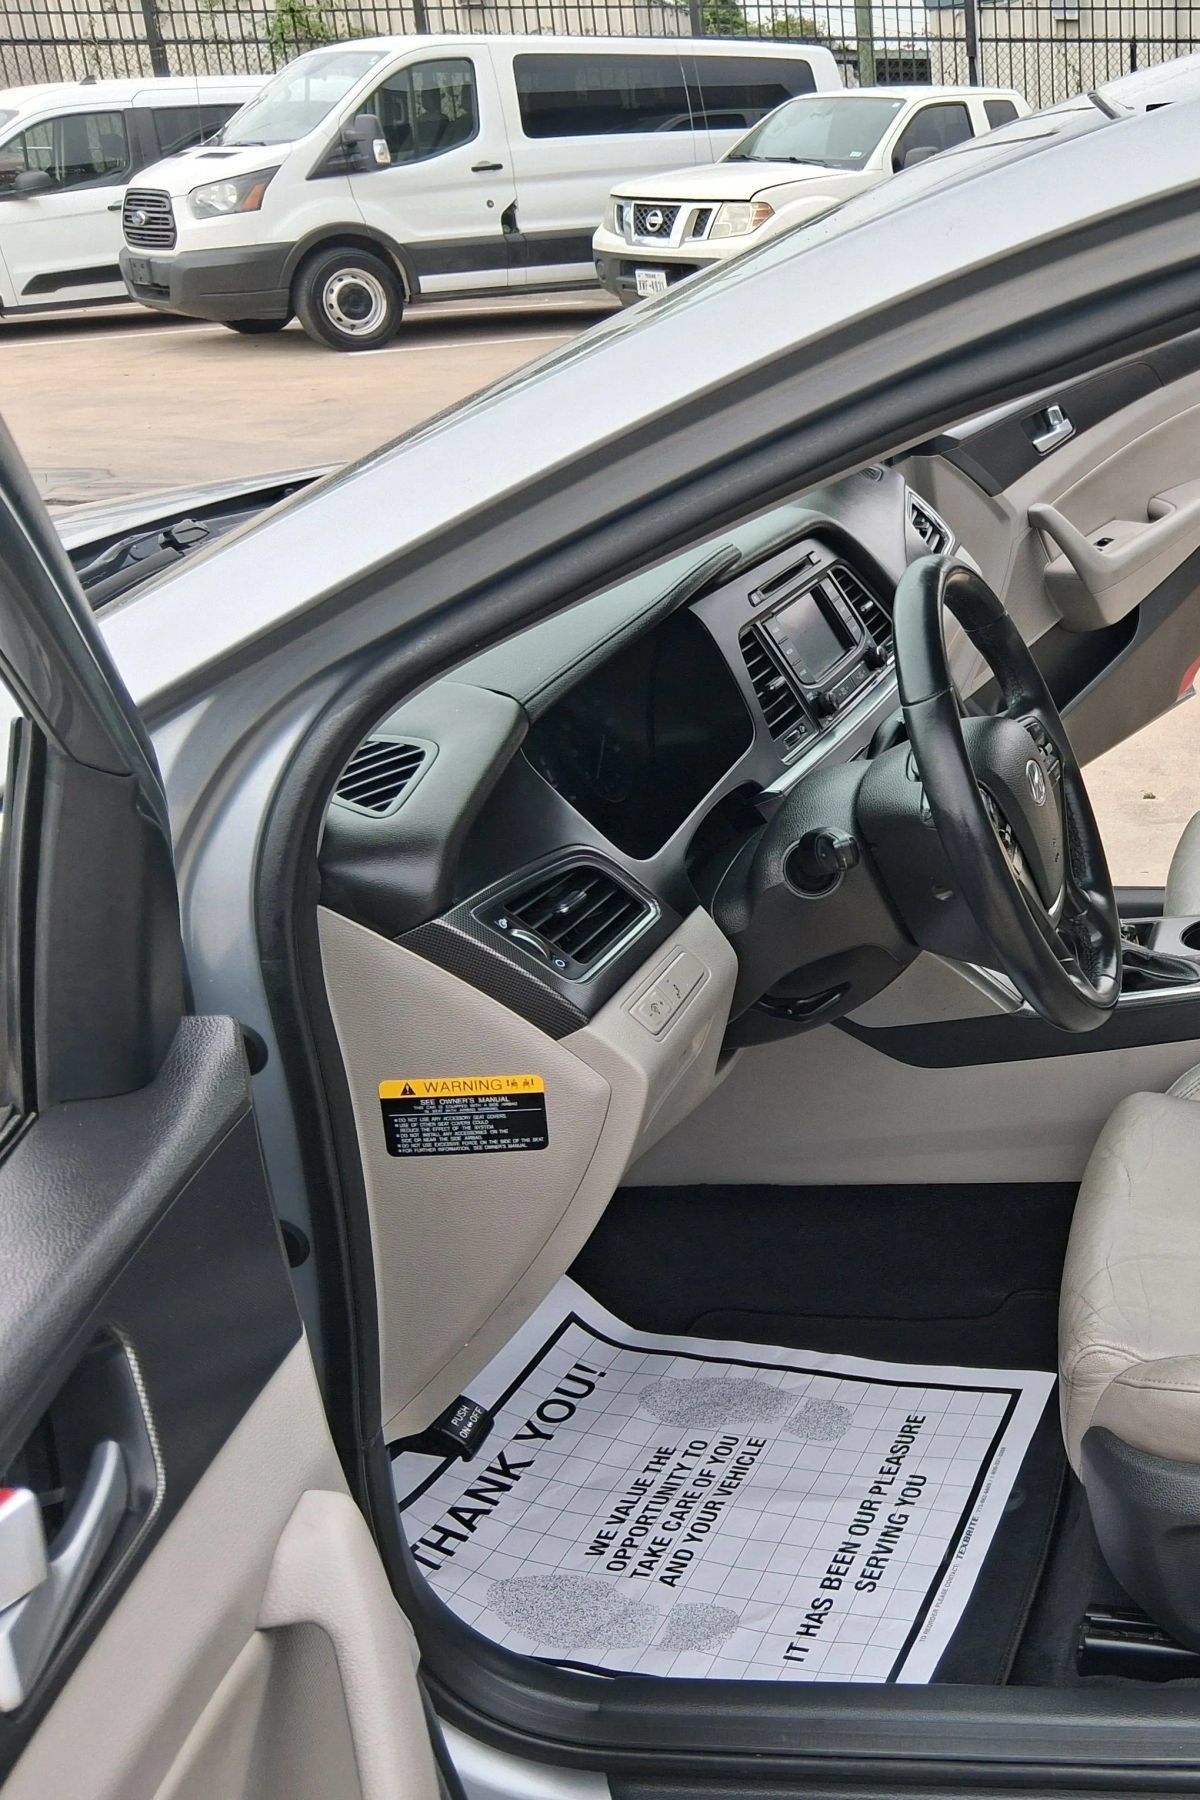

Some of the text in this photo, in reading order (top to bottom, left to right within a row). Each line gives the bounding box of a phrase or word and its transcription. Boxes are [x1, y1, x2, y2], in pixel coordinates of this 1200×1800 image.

[423, 1078, 502, 1092] WARNING
[410, 1363, 606, 1570] THANK YOU!
[451, 1405, 470, 1426] PUSH
[460, 1406, 482, 1438] ON OFF
[584, 1446, 676, 1556] WE VALUE THE
[606, 1440, 708, 1572] OPPORTUNITY TO
[629, 1436, 740, 1578] TAKE CARE OF YOU
[659, 1438, 766, 1588] AND YOUR VEHICLE
[783, 1414, 926, 1662] IT HAS BEEN OUR PLEASURE
[854, 1474, 928, 1593] SERVING YOU
[956, 1516, 980, 1560] TEXBRITE
